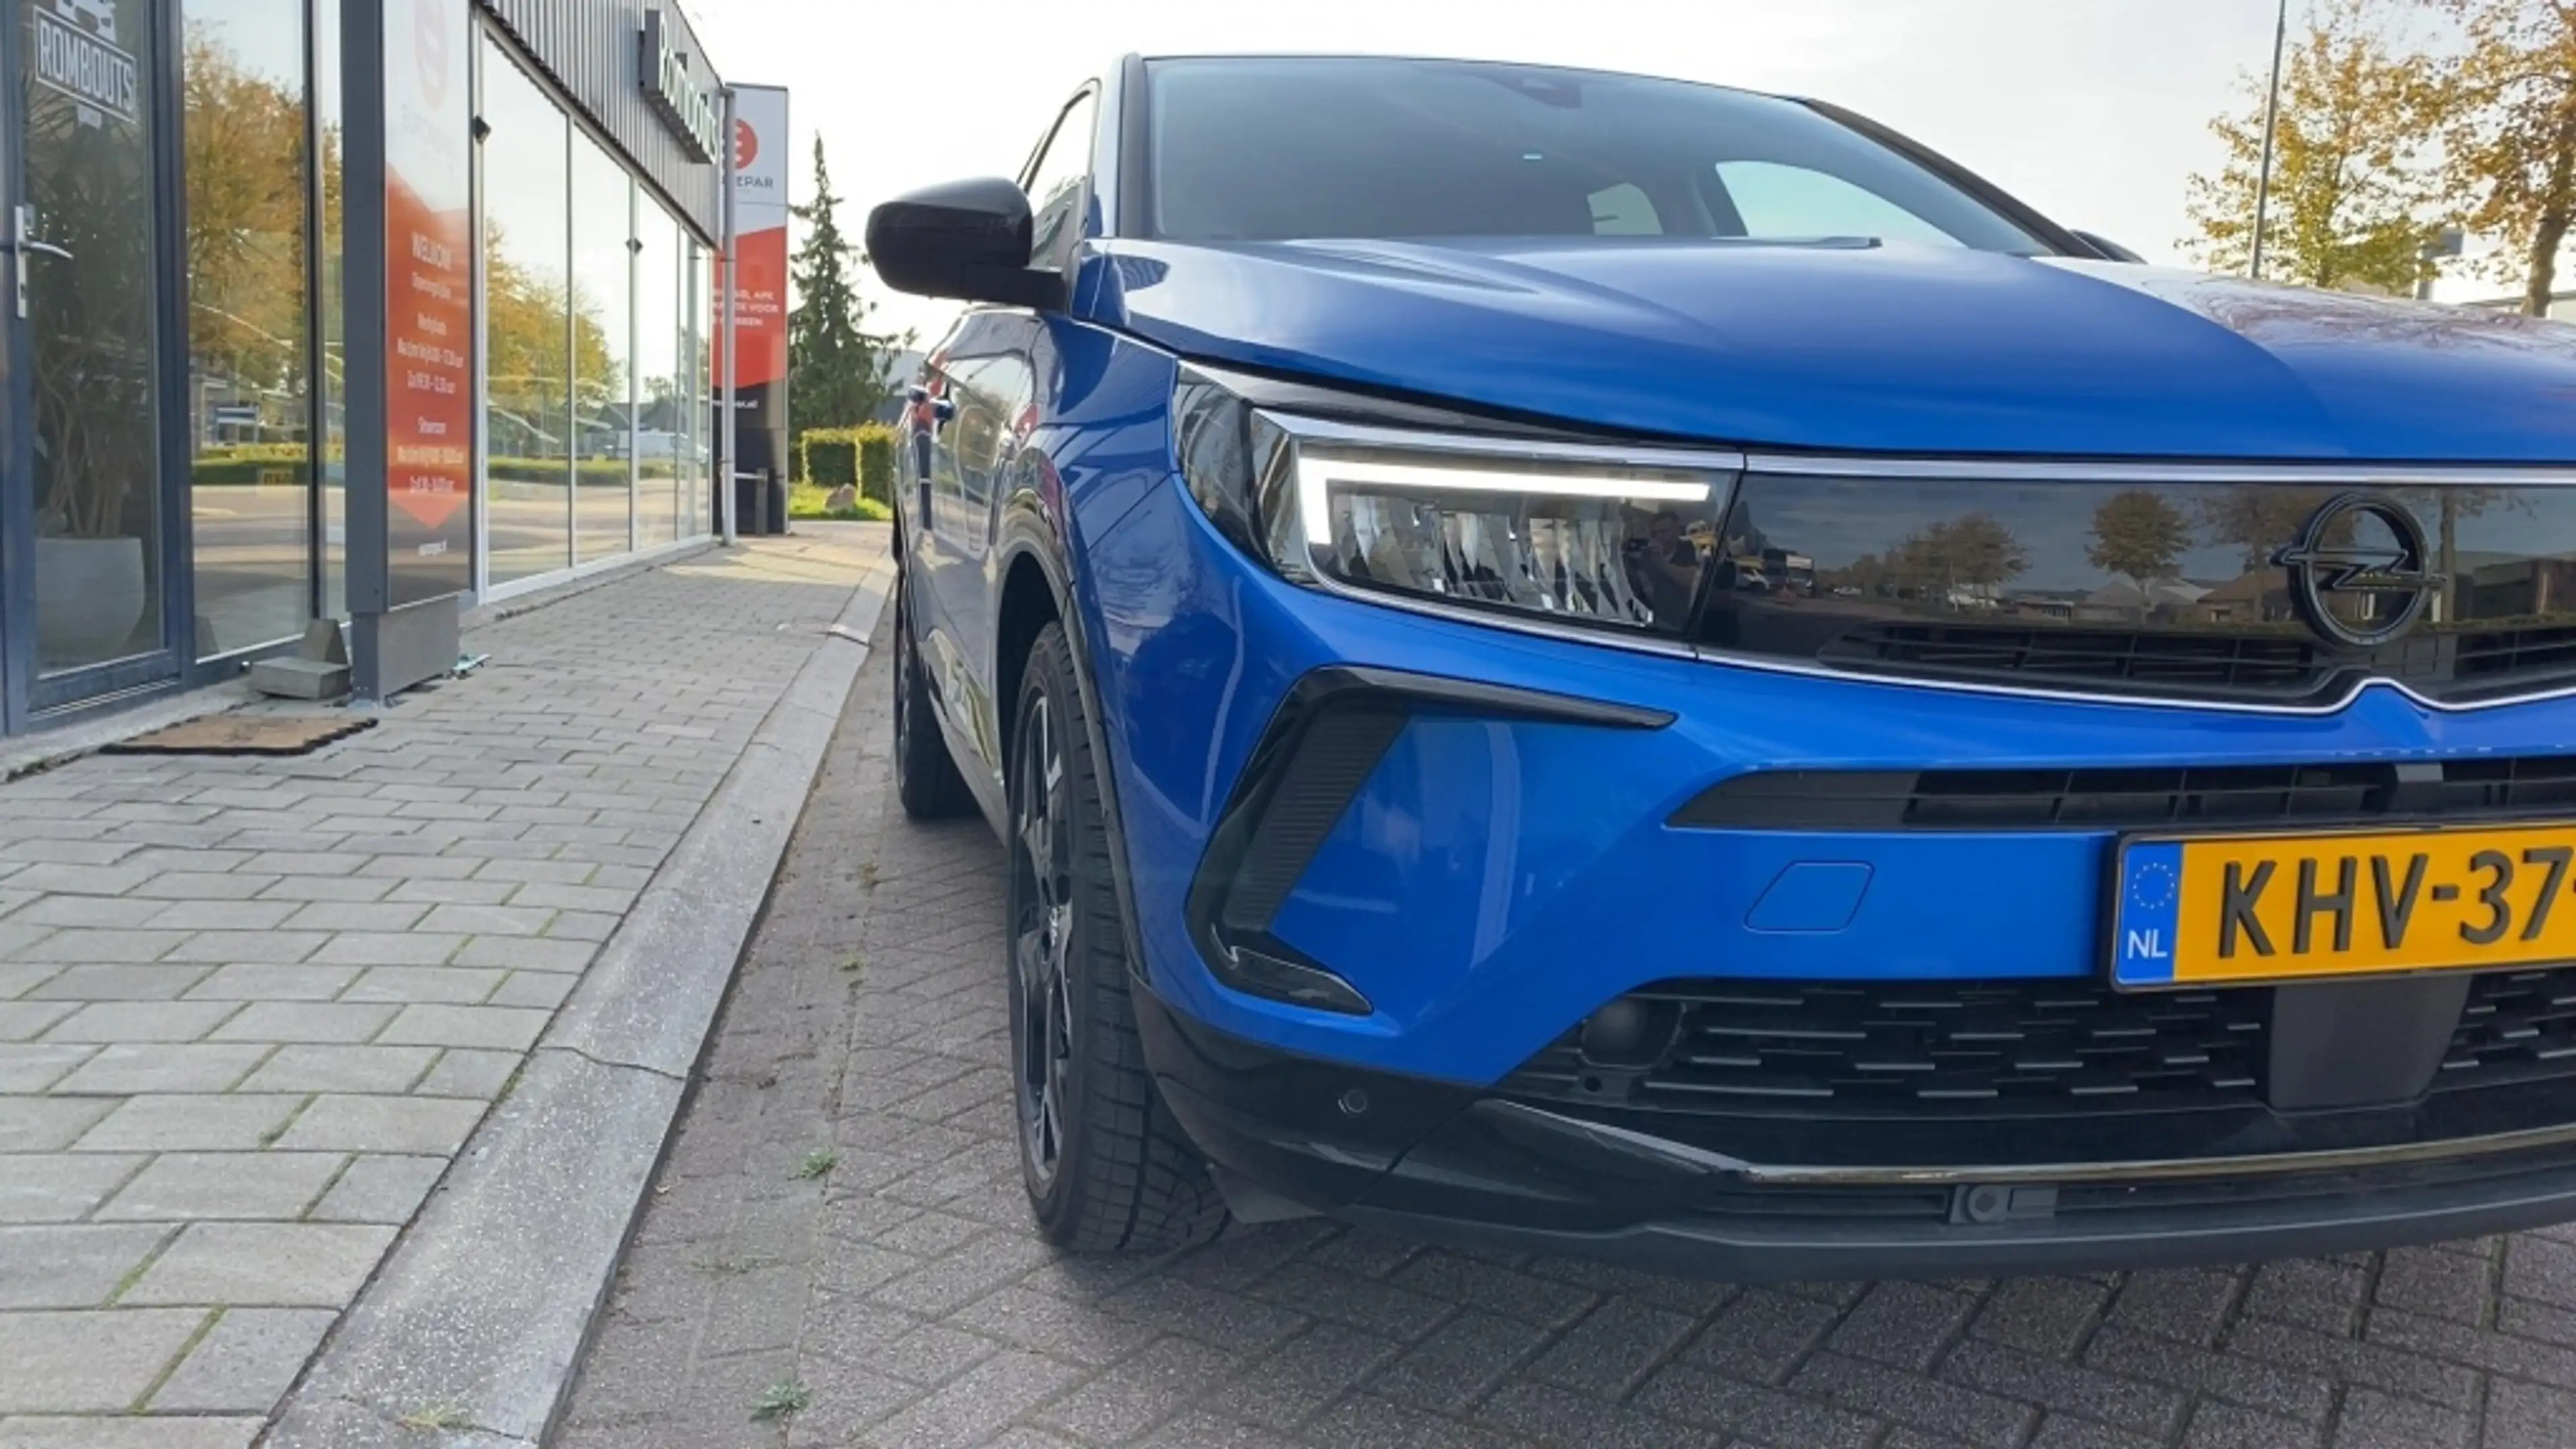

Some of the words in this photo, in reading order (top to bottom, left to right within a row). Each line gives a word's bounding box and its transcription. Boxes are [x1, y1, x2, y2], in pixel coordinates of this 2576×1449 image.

[40, 18, 133, 112] ROMBOUTS
[734, 176, 773, 189] EPAR
[2218, 847, 2576, 957] KHV-37
[2127, 930, 2167, 959] NL
